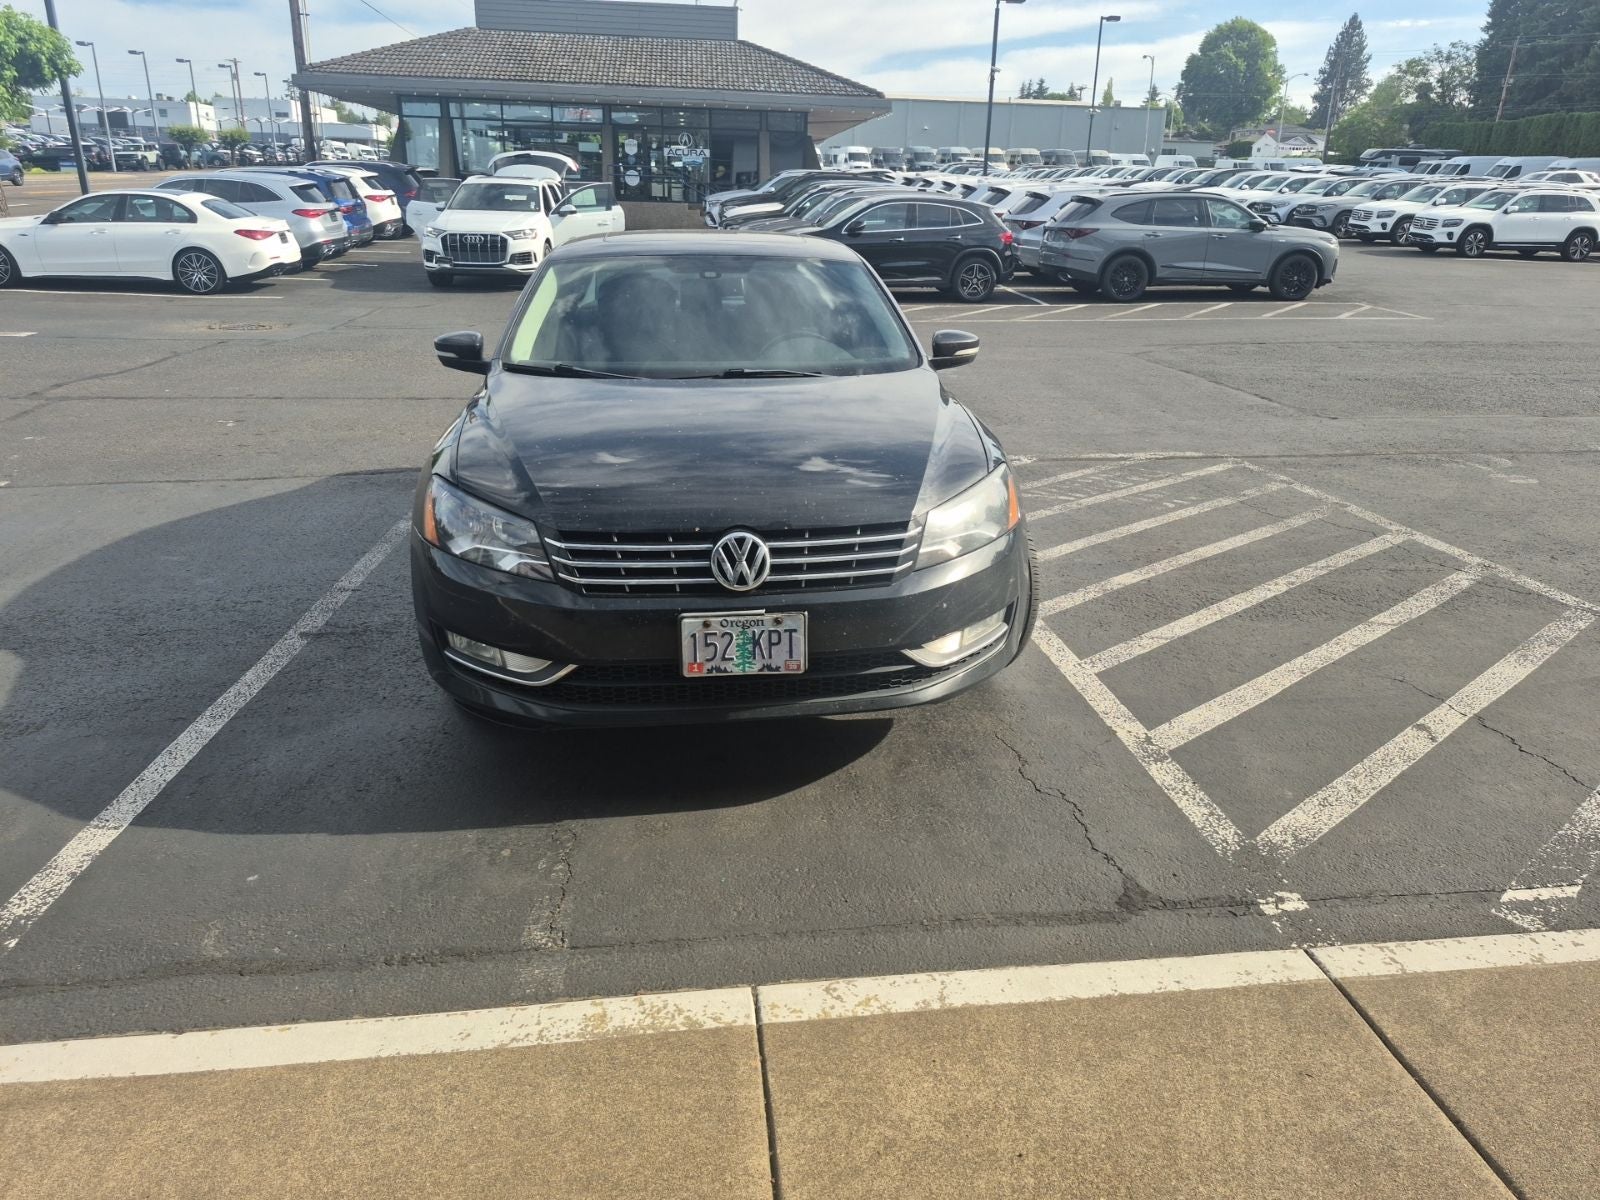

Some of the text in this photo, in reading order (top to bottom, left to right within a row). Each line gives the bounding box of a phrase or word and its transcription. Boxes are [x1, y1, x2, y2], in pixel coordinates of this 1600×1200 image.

[667, 149, 707, 157] ACURA
[711, 532, 770, 591] VW
[719, 618, 765, 629] Oregon
[690, 628, 798, 663] 152 KPT
